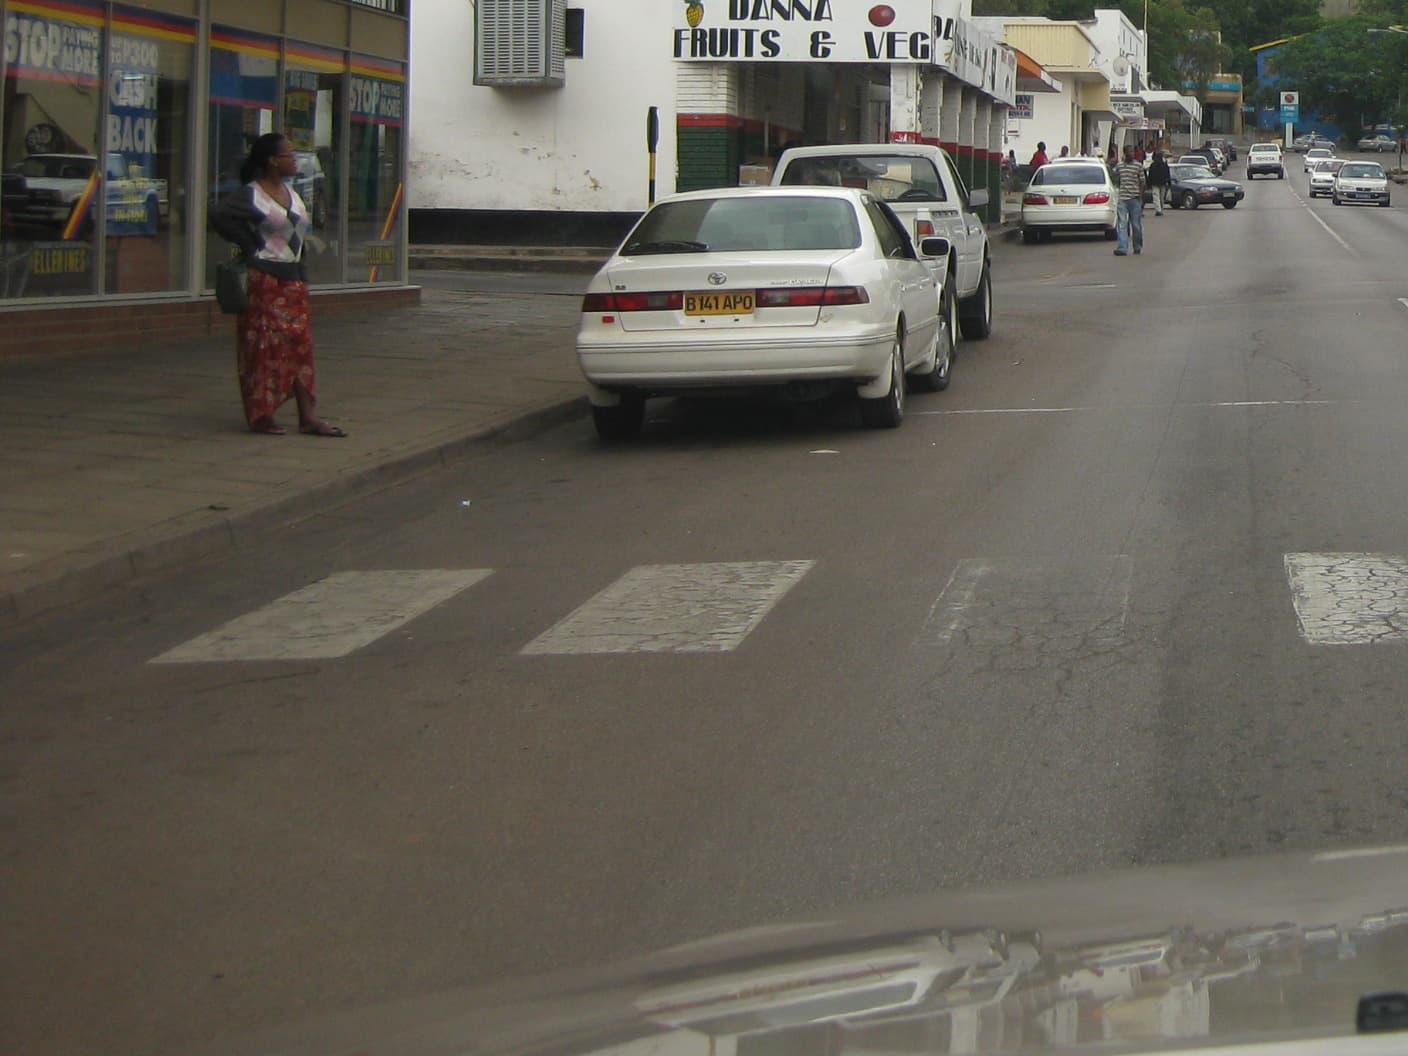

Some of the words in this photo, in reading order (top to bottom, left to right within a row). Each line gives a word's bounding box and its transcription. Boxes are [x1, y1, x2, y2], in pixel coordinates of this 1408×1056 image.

[4, 16, 61, 69] STOP
[61, 45, 98, 75] MORE
[673, 28, 781, 58] FRUITS
[810, 30, 836, 58] &
[864, 31, 930, 60] VEG
[109, 69, 158, 110] CASH
[350, 77, 380, 115] STOP
[106, 114, 158, 154] BACK
[686, 297, 696, 312] B
[699, 296, 719, 311] 141
